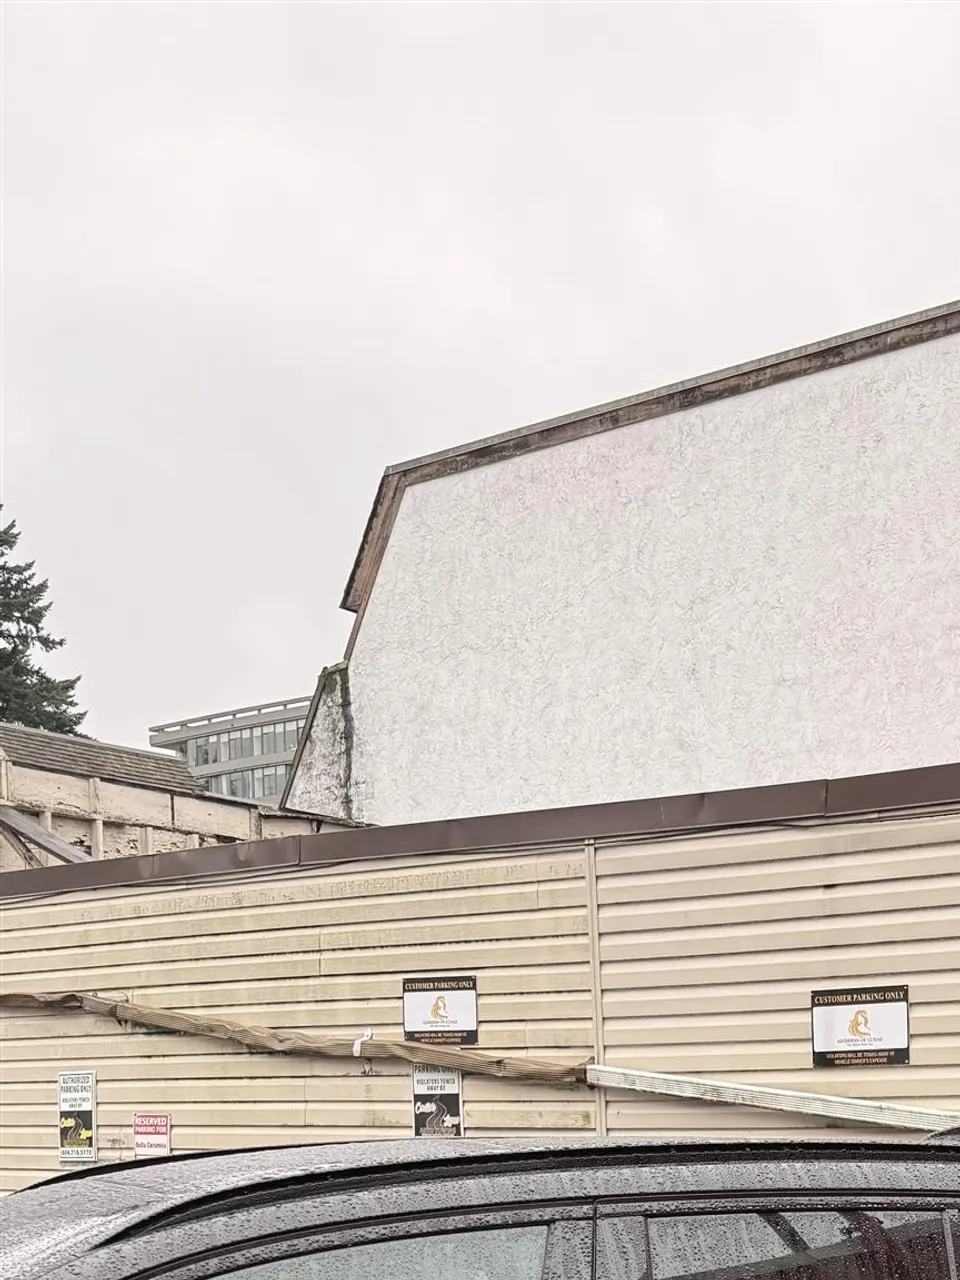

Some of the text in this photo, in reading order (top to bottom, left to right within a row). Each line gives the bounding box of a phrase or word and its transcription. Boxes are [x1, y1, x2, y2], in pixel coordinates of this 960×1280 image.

[815, 991, 904, 1004] CUSTOMER PARKING ONLY
